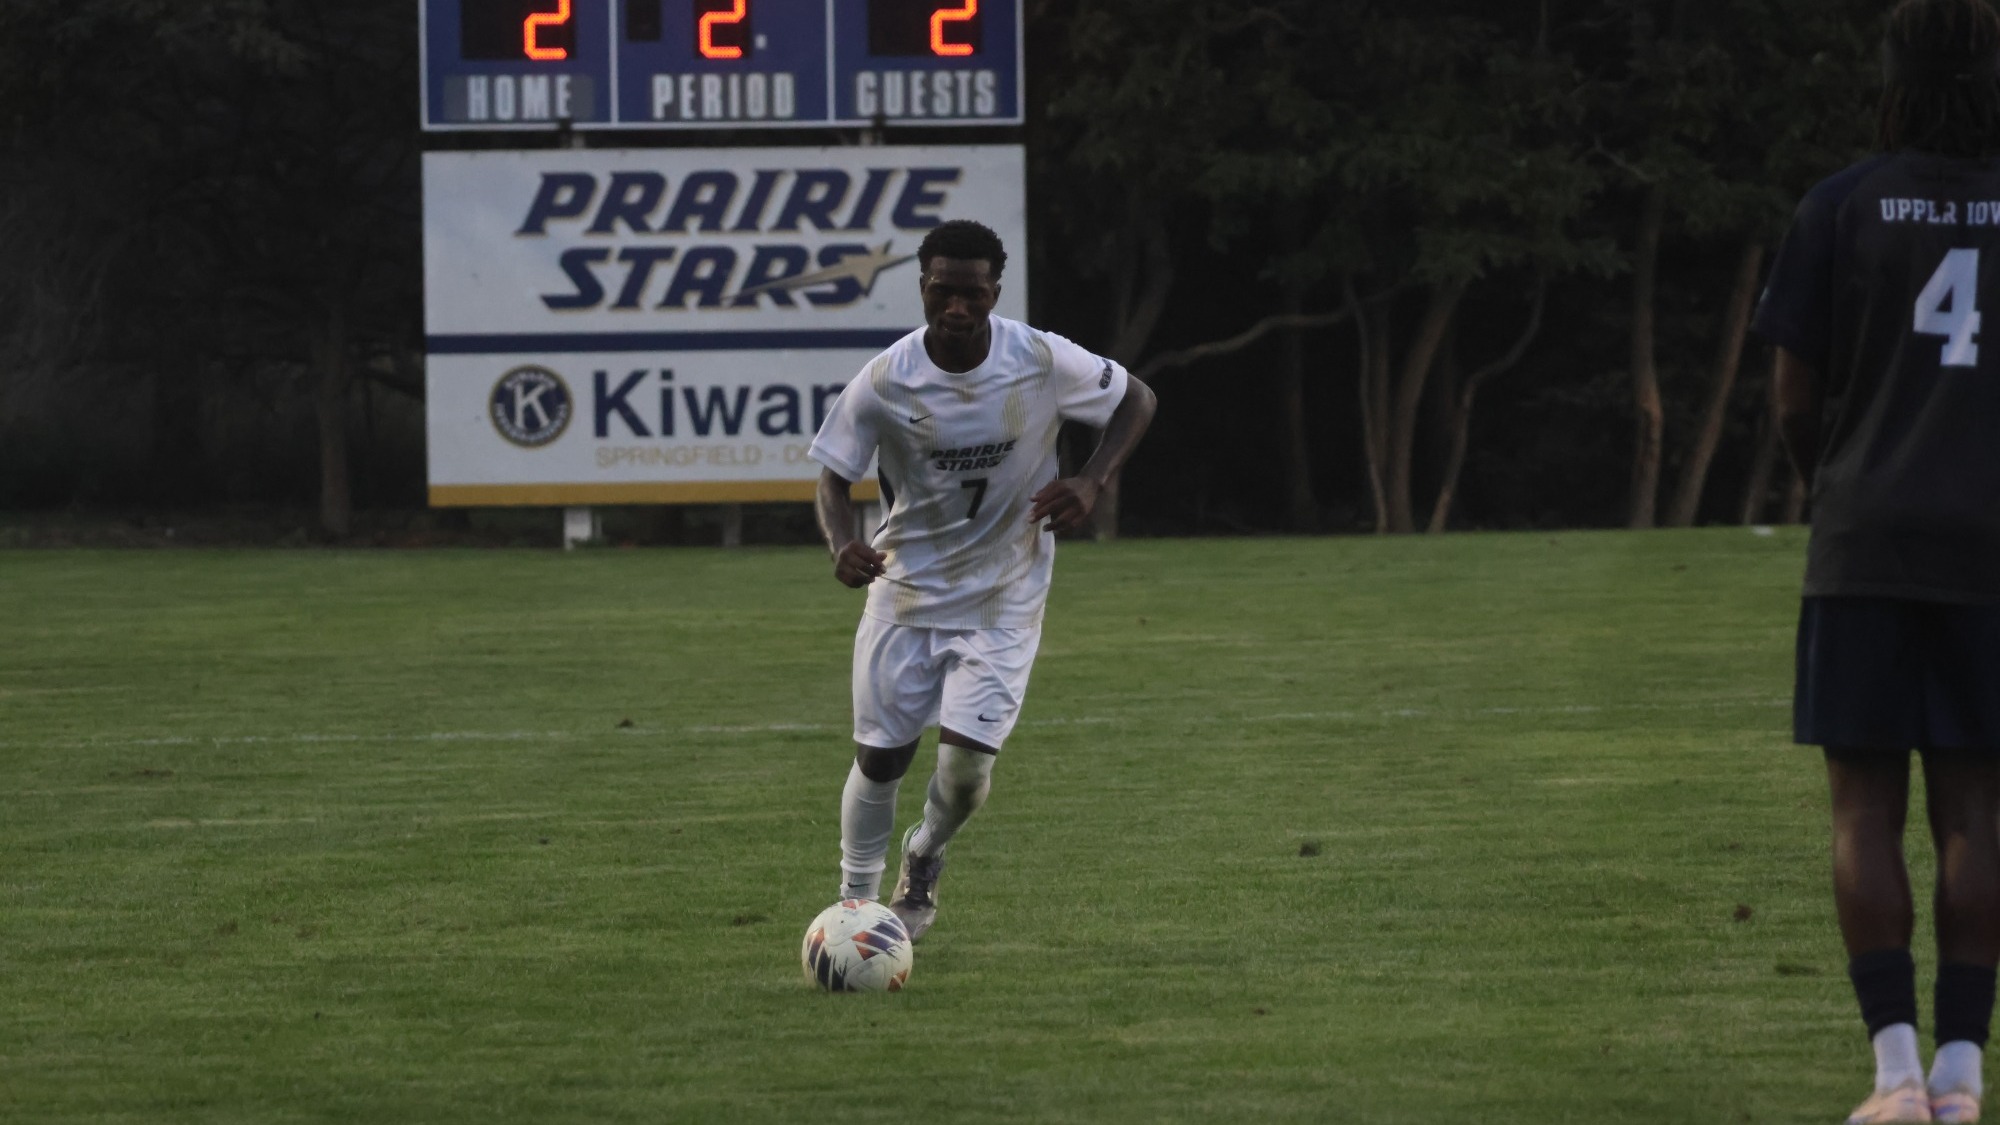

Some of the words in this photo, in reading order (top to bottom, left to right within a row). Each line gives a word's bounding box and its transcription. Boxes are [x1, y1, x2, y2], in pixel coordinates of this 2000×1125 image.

[524, 0, 571, 60] 2
[699, 0, 746, 59] 2
[930, 0, 977, 56] 2
[467, 74, 572, 120] HOME
[653, 73, 795, 119] PERIOD
[856, 70, 996, 117] GUESTS
[514, 167, 962, 237] PRAIRIE
[540, 244, 874, 312] STARS
[1913, 248, 1981, 367] 4
[596, 444, 762, 468] SPRINGFIELD
[930, 440, 1017, 459] PRAIRIE
[935, 455, 1003, 472] STARS
[961, 478, 988, 520] 7
